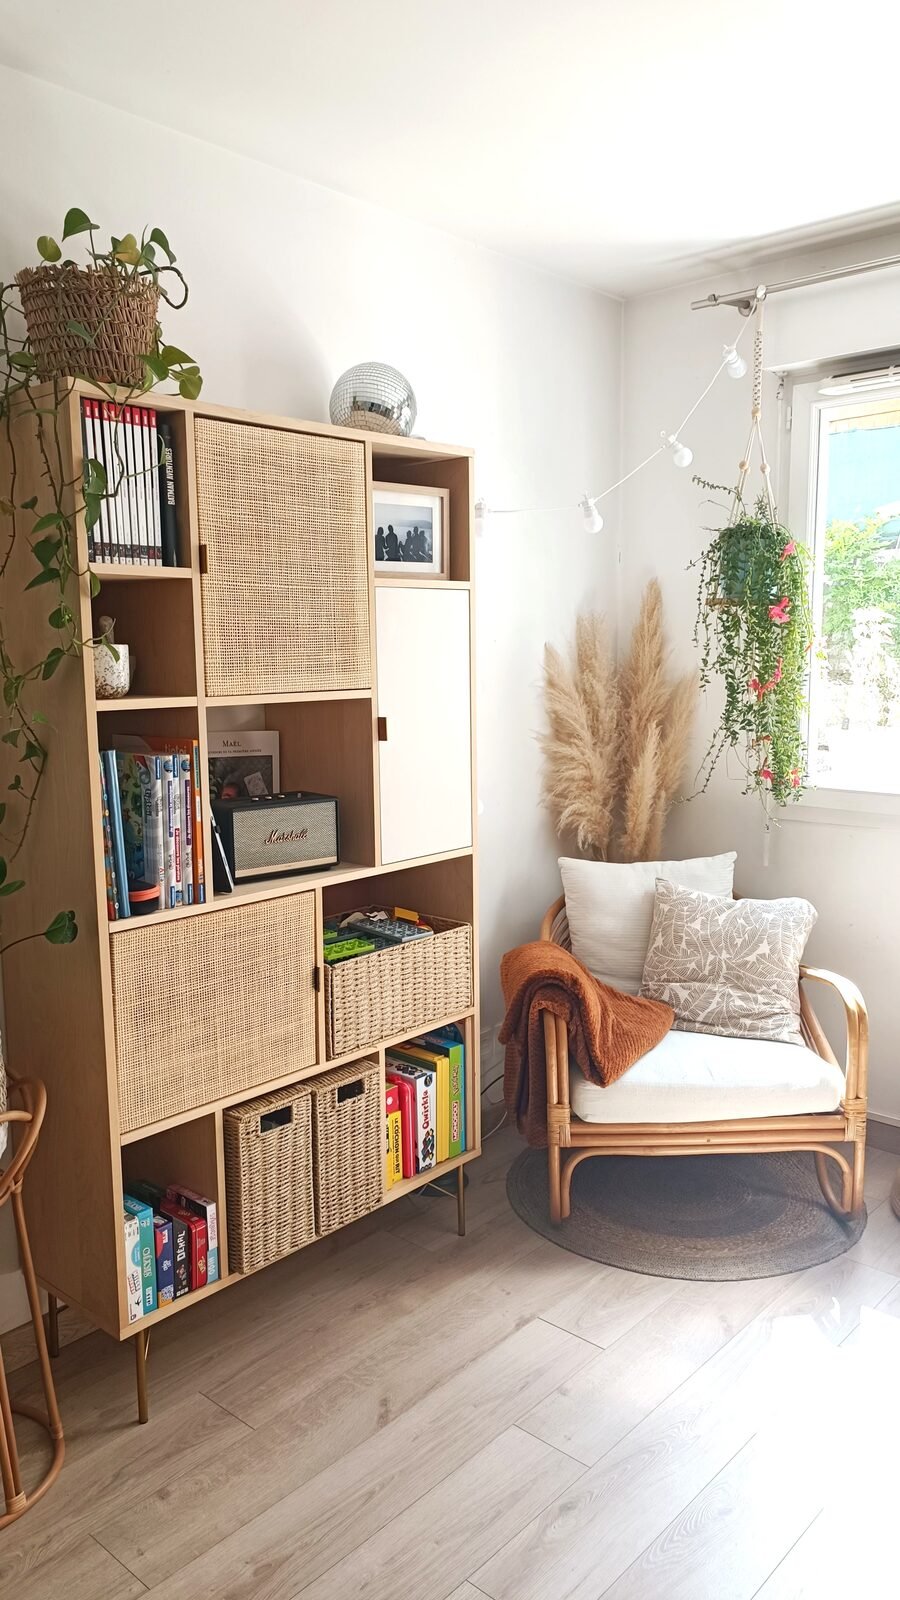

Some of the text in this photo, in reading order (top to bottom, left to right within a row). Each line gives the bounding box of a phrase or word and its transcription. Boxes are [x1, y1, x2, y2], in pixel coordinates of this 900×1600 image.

[164, 447, 176, 506] BATMAN AVENTURES
[264, 828, 308, 845] Marshall
[421, 1090, 430, 1130] Qwirkle
[142, 1247, 153, 1278] SKYJO
